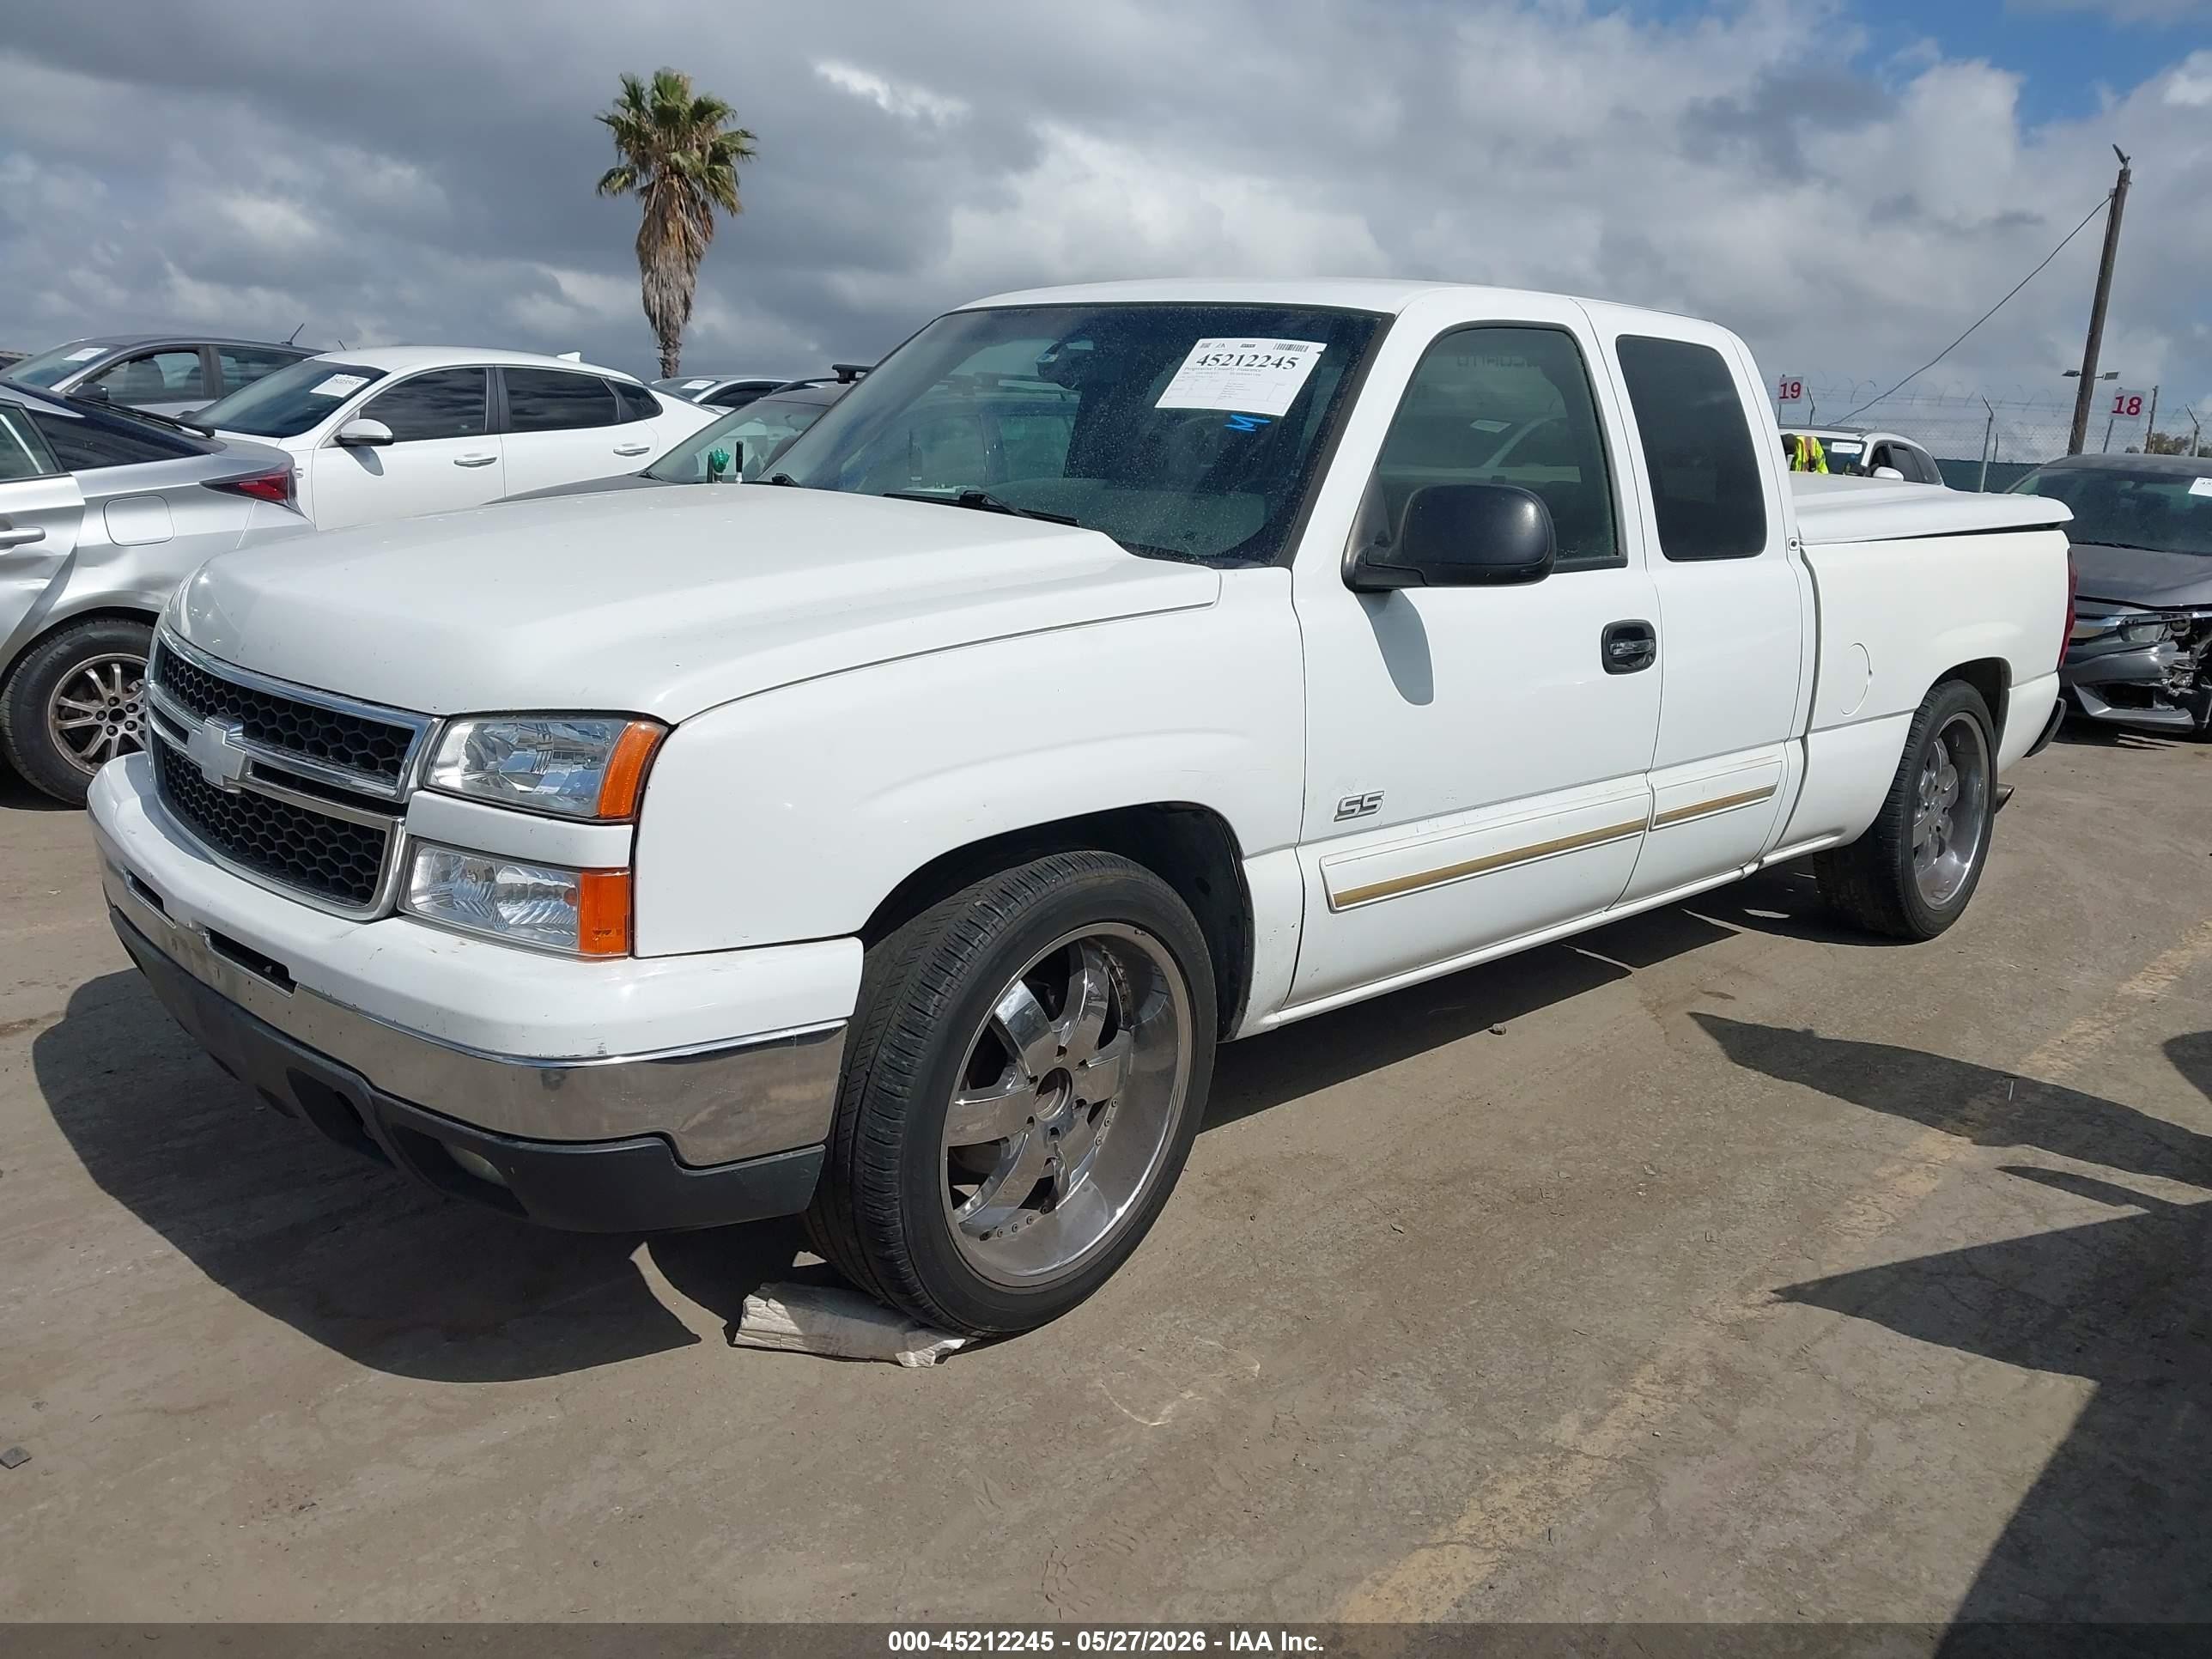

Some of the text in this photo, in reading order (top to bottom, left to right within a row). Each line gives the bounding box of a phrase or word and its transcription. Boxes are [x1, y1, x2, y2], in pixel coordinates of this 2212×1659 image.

[1195, 353, 1300, 370] 45212245
[1778, 381, 1802, 400] 19
[2112, 395, 2142, 416] 18
[1334, 790, 1385, 823] SS
